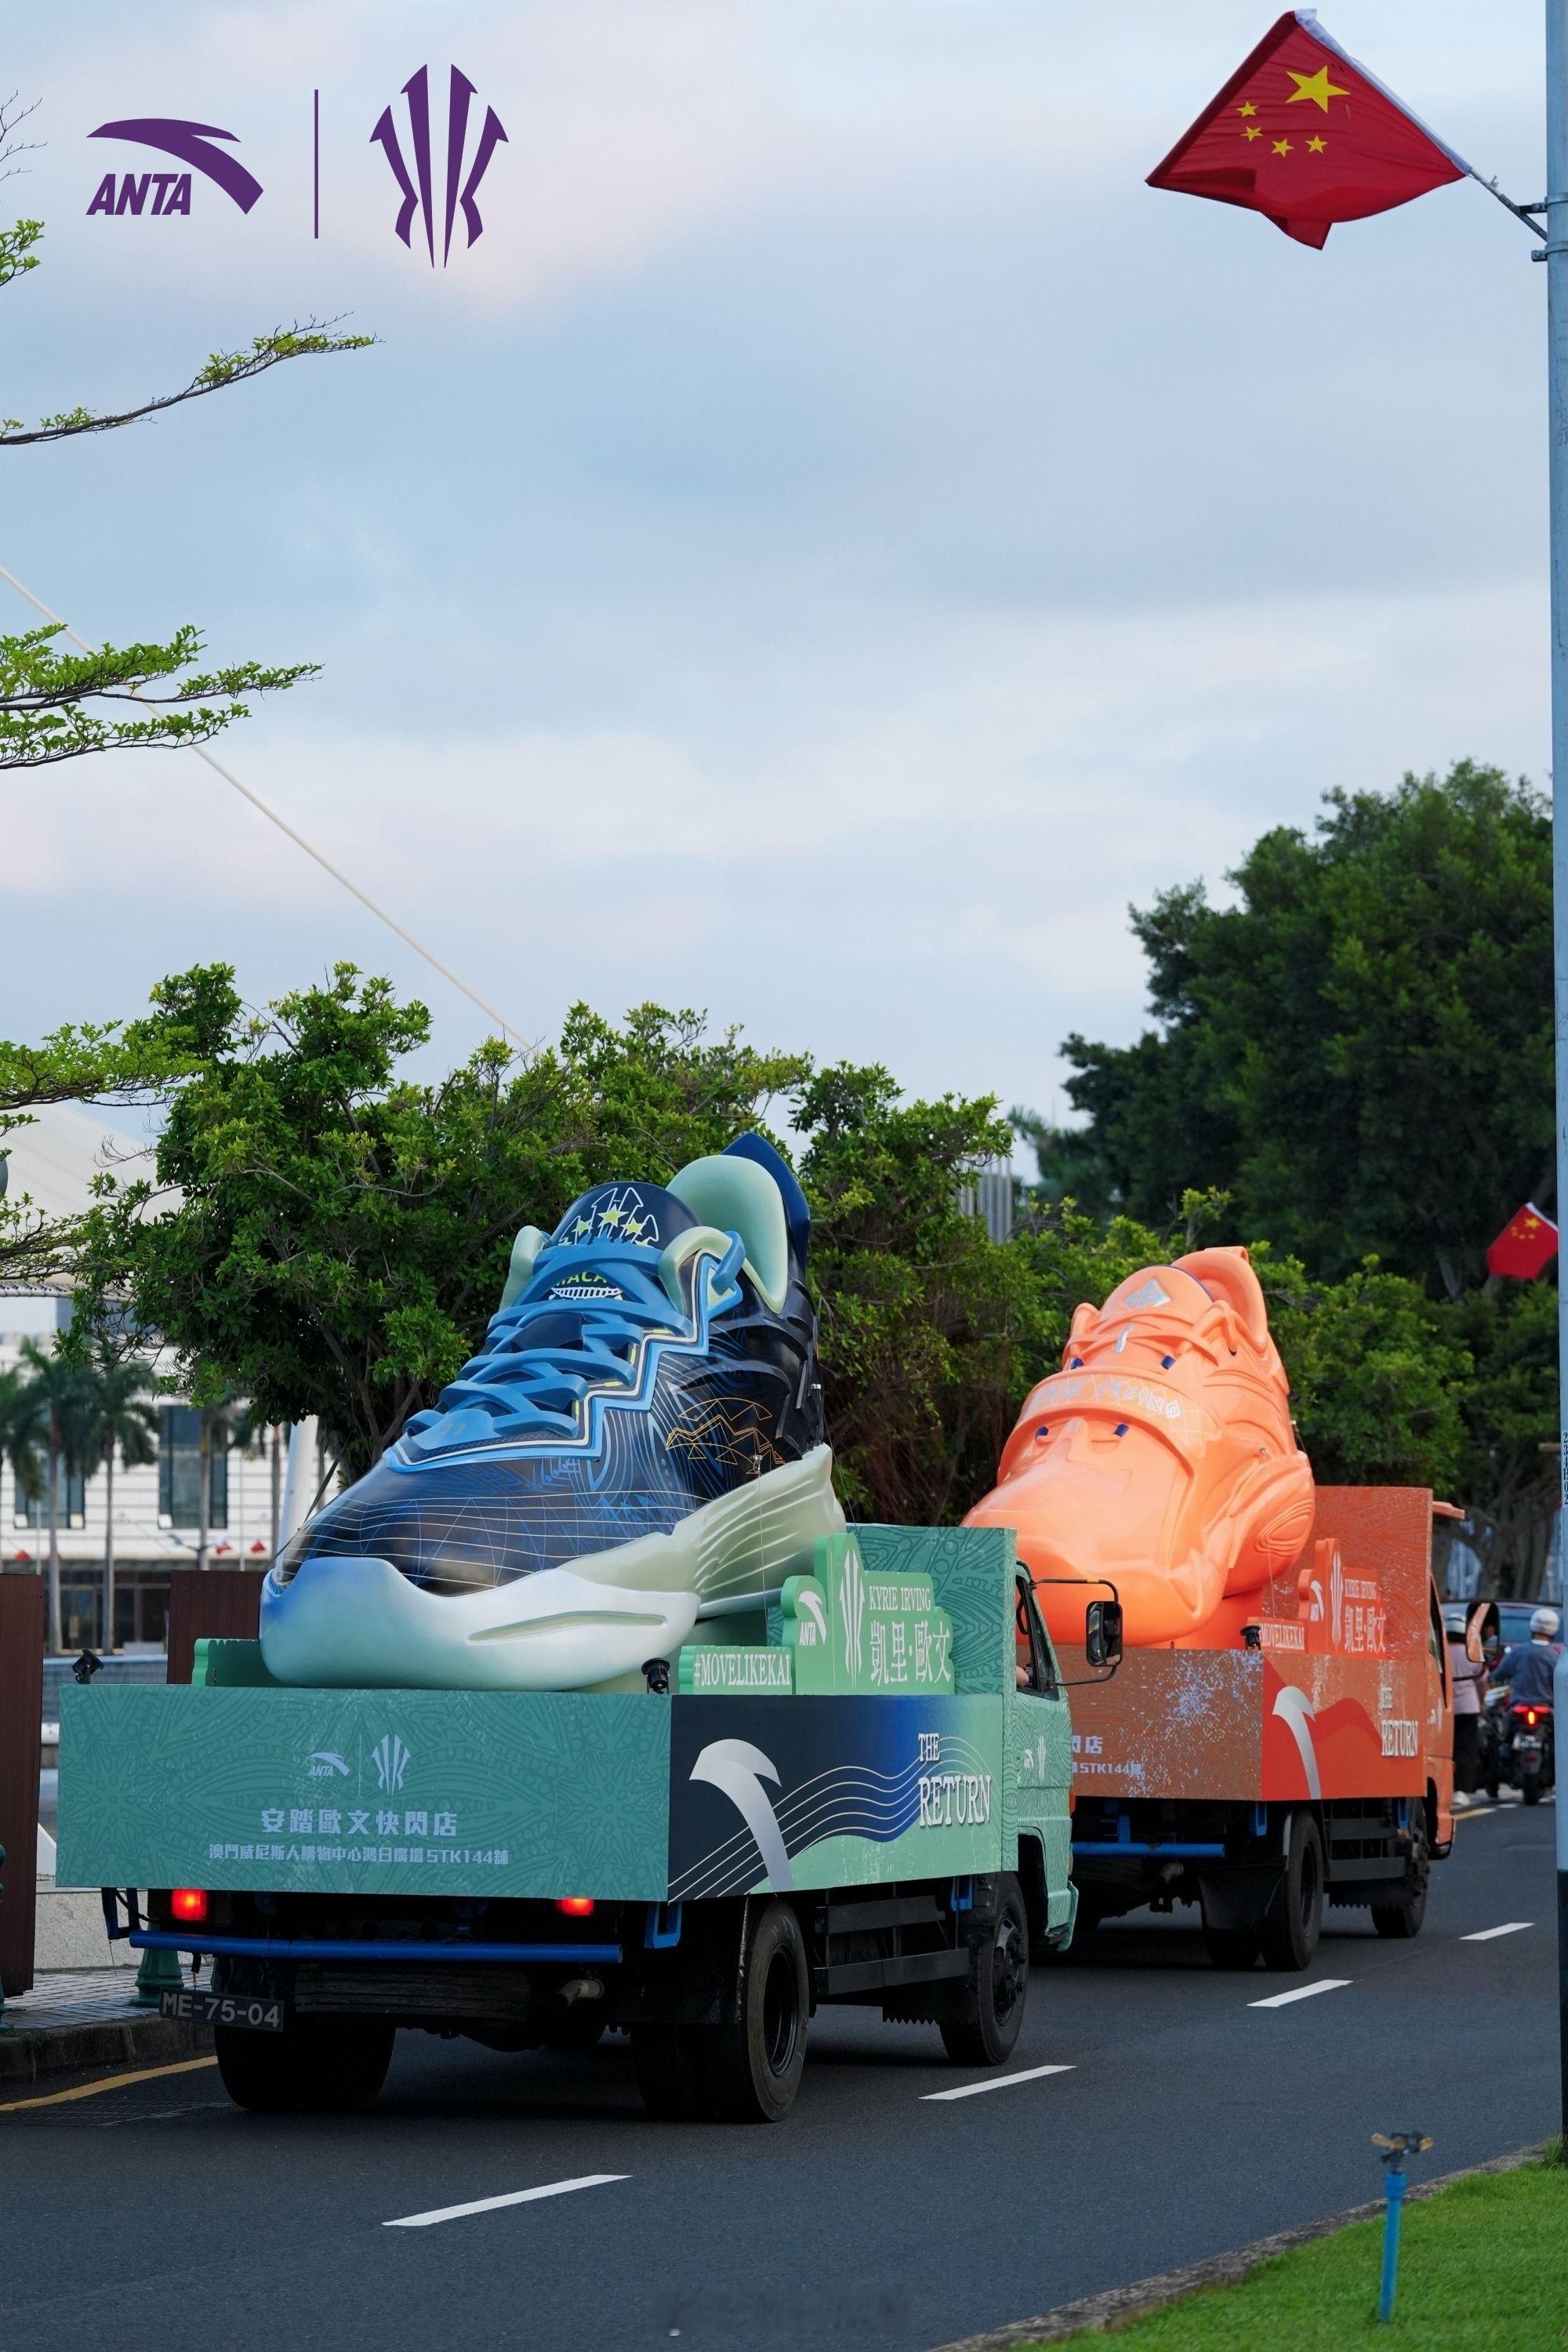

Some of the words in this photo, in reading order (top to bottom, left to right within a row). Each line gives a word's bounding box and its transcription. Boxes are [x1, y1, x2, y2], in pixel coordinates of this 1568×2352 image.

[869, 1585, 898, 1611] KYRIE
[900, 1587, 931, 1612] IRVING
[799, 1621, 816, 1646] ANTA
[694, 1653, 791, 1687] #MOVELIKEKAI
[918, 1733, 939, 1762] THE
[1381, 1719, 1417, 1757] RETURN
[308, 1766, 333, 1777] ANTA
[918, 1774, 991, 1828] RETURN
[261, 1808, 458, 1836] 安踏歐文快閃店
[162, 1992, 280, 2027] ME-75-04
